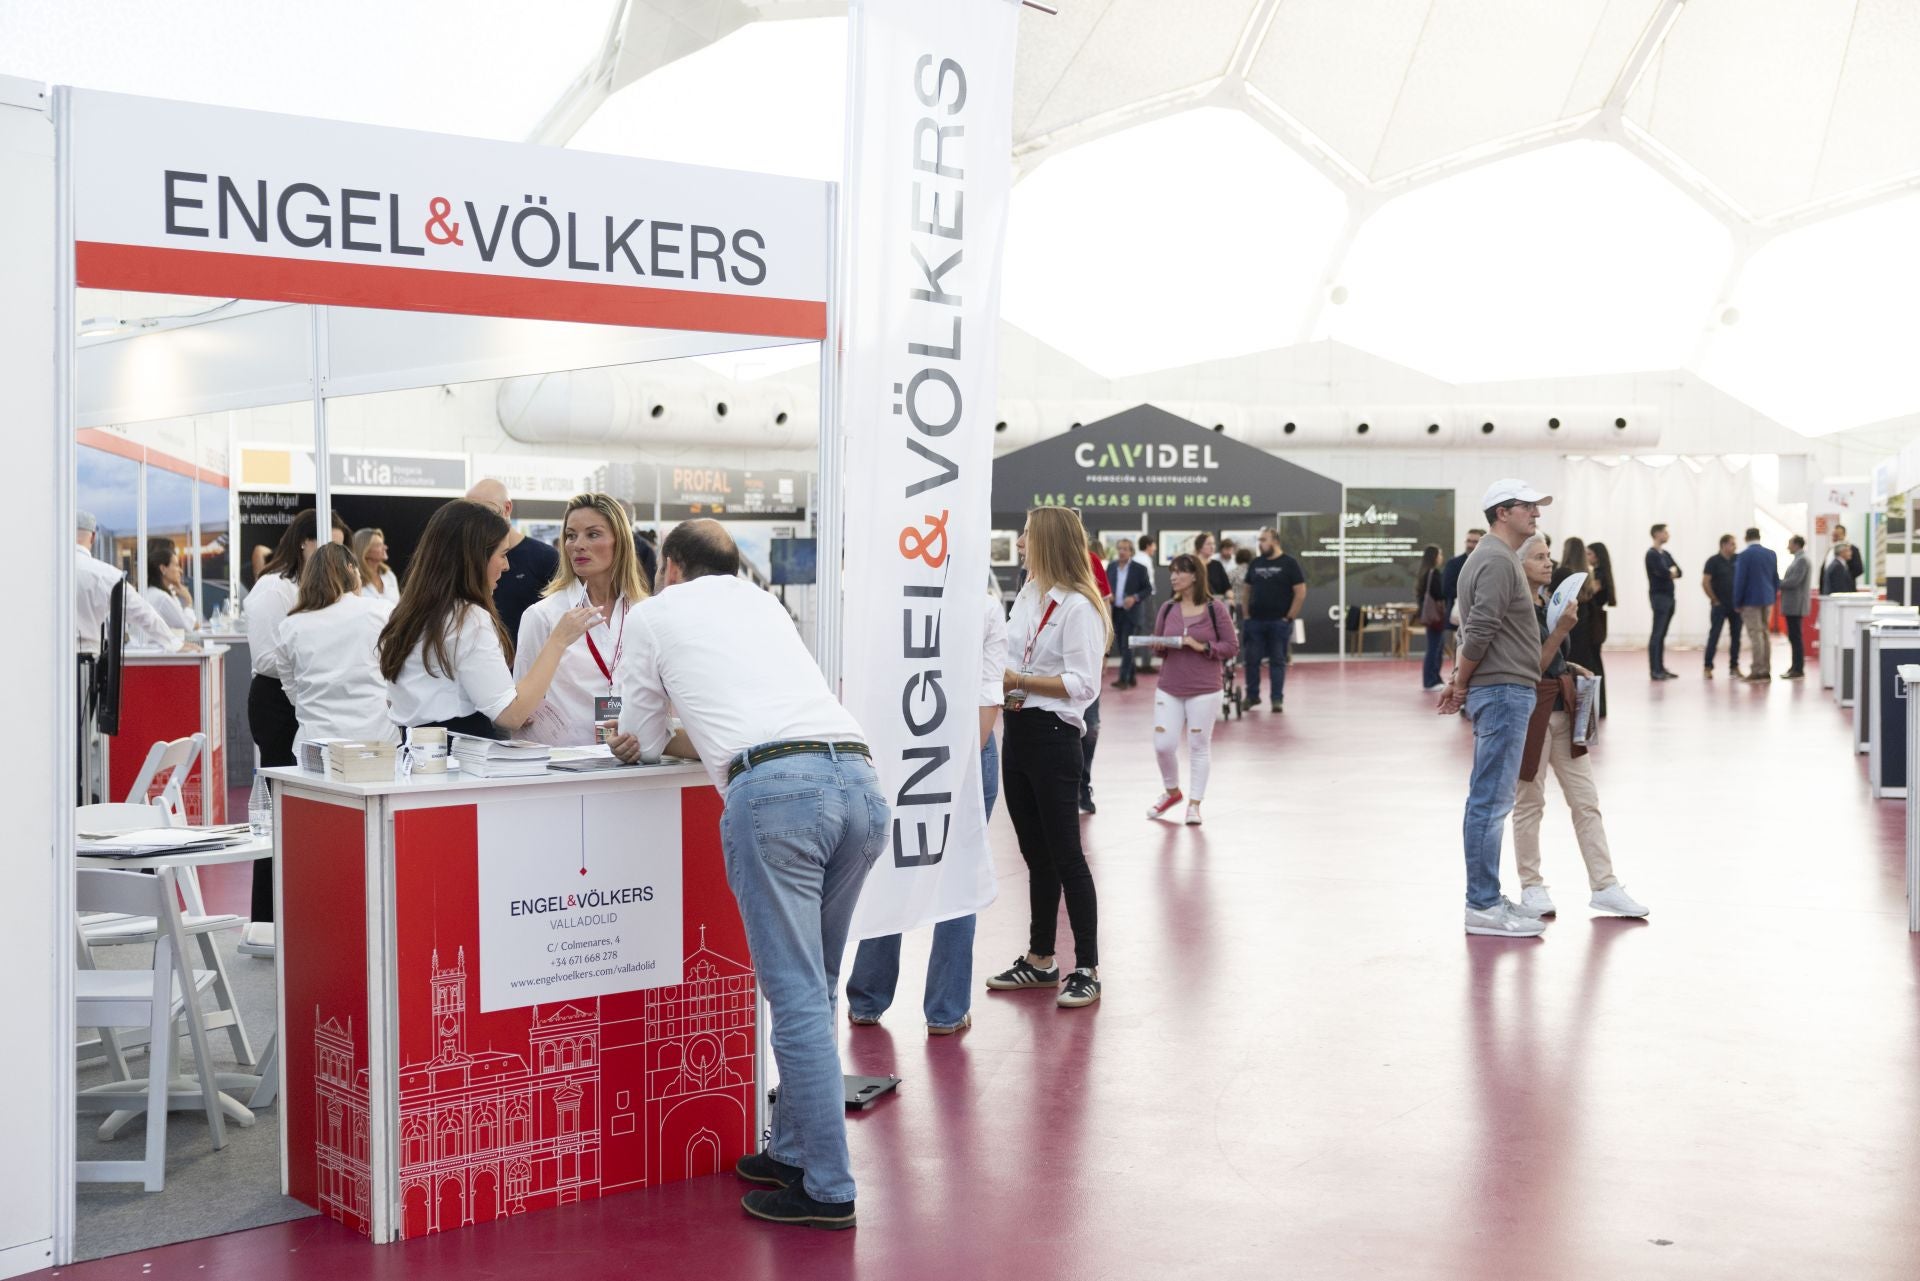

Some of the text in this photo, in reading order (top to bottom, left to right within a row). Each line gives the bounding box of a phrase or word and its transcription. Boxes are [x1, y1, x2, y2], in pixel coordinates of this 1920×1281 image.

[164, 169, 767, 286] ENGEL&VÖLKERS
[892, 52, 968, 868] ENGEL&VÖLKERS
[1074, 442, 1219, 469] CAVIDEL
[673, 467, 732, 494] PROFAL
[1034, 493, 1252, 508] LAS CASAS BIEN HECHAS
[510, 885, 654, 917] ENGEL&VÖLKERS
[550, 912, 618, 930] VALLADOLID
[547, 935, 621, 953] C/ Colmenares, 4
[550, 950, 618, 968] +34 671 668 278
[510, 960, 656, 988] www.engelvoelkers.com/valladolid
